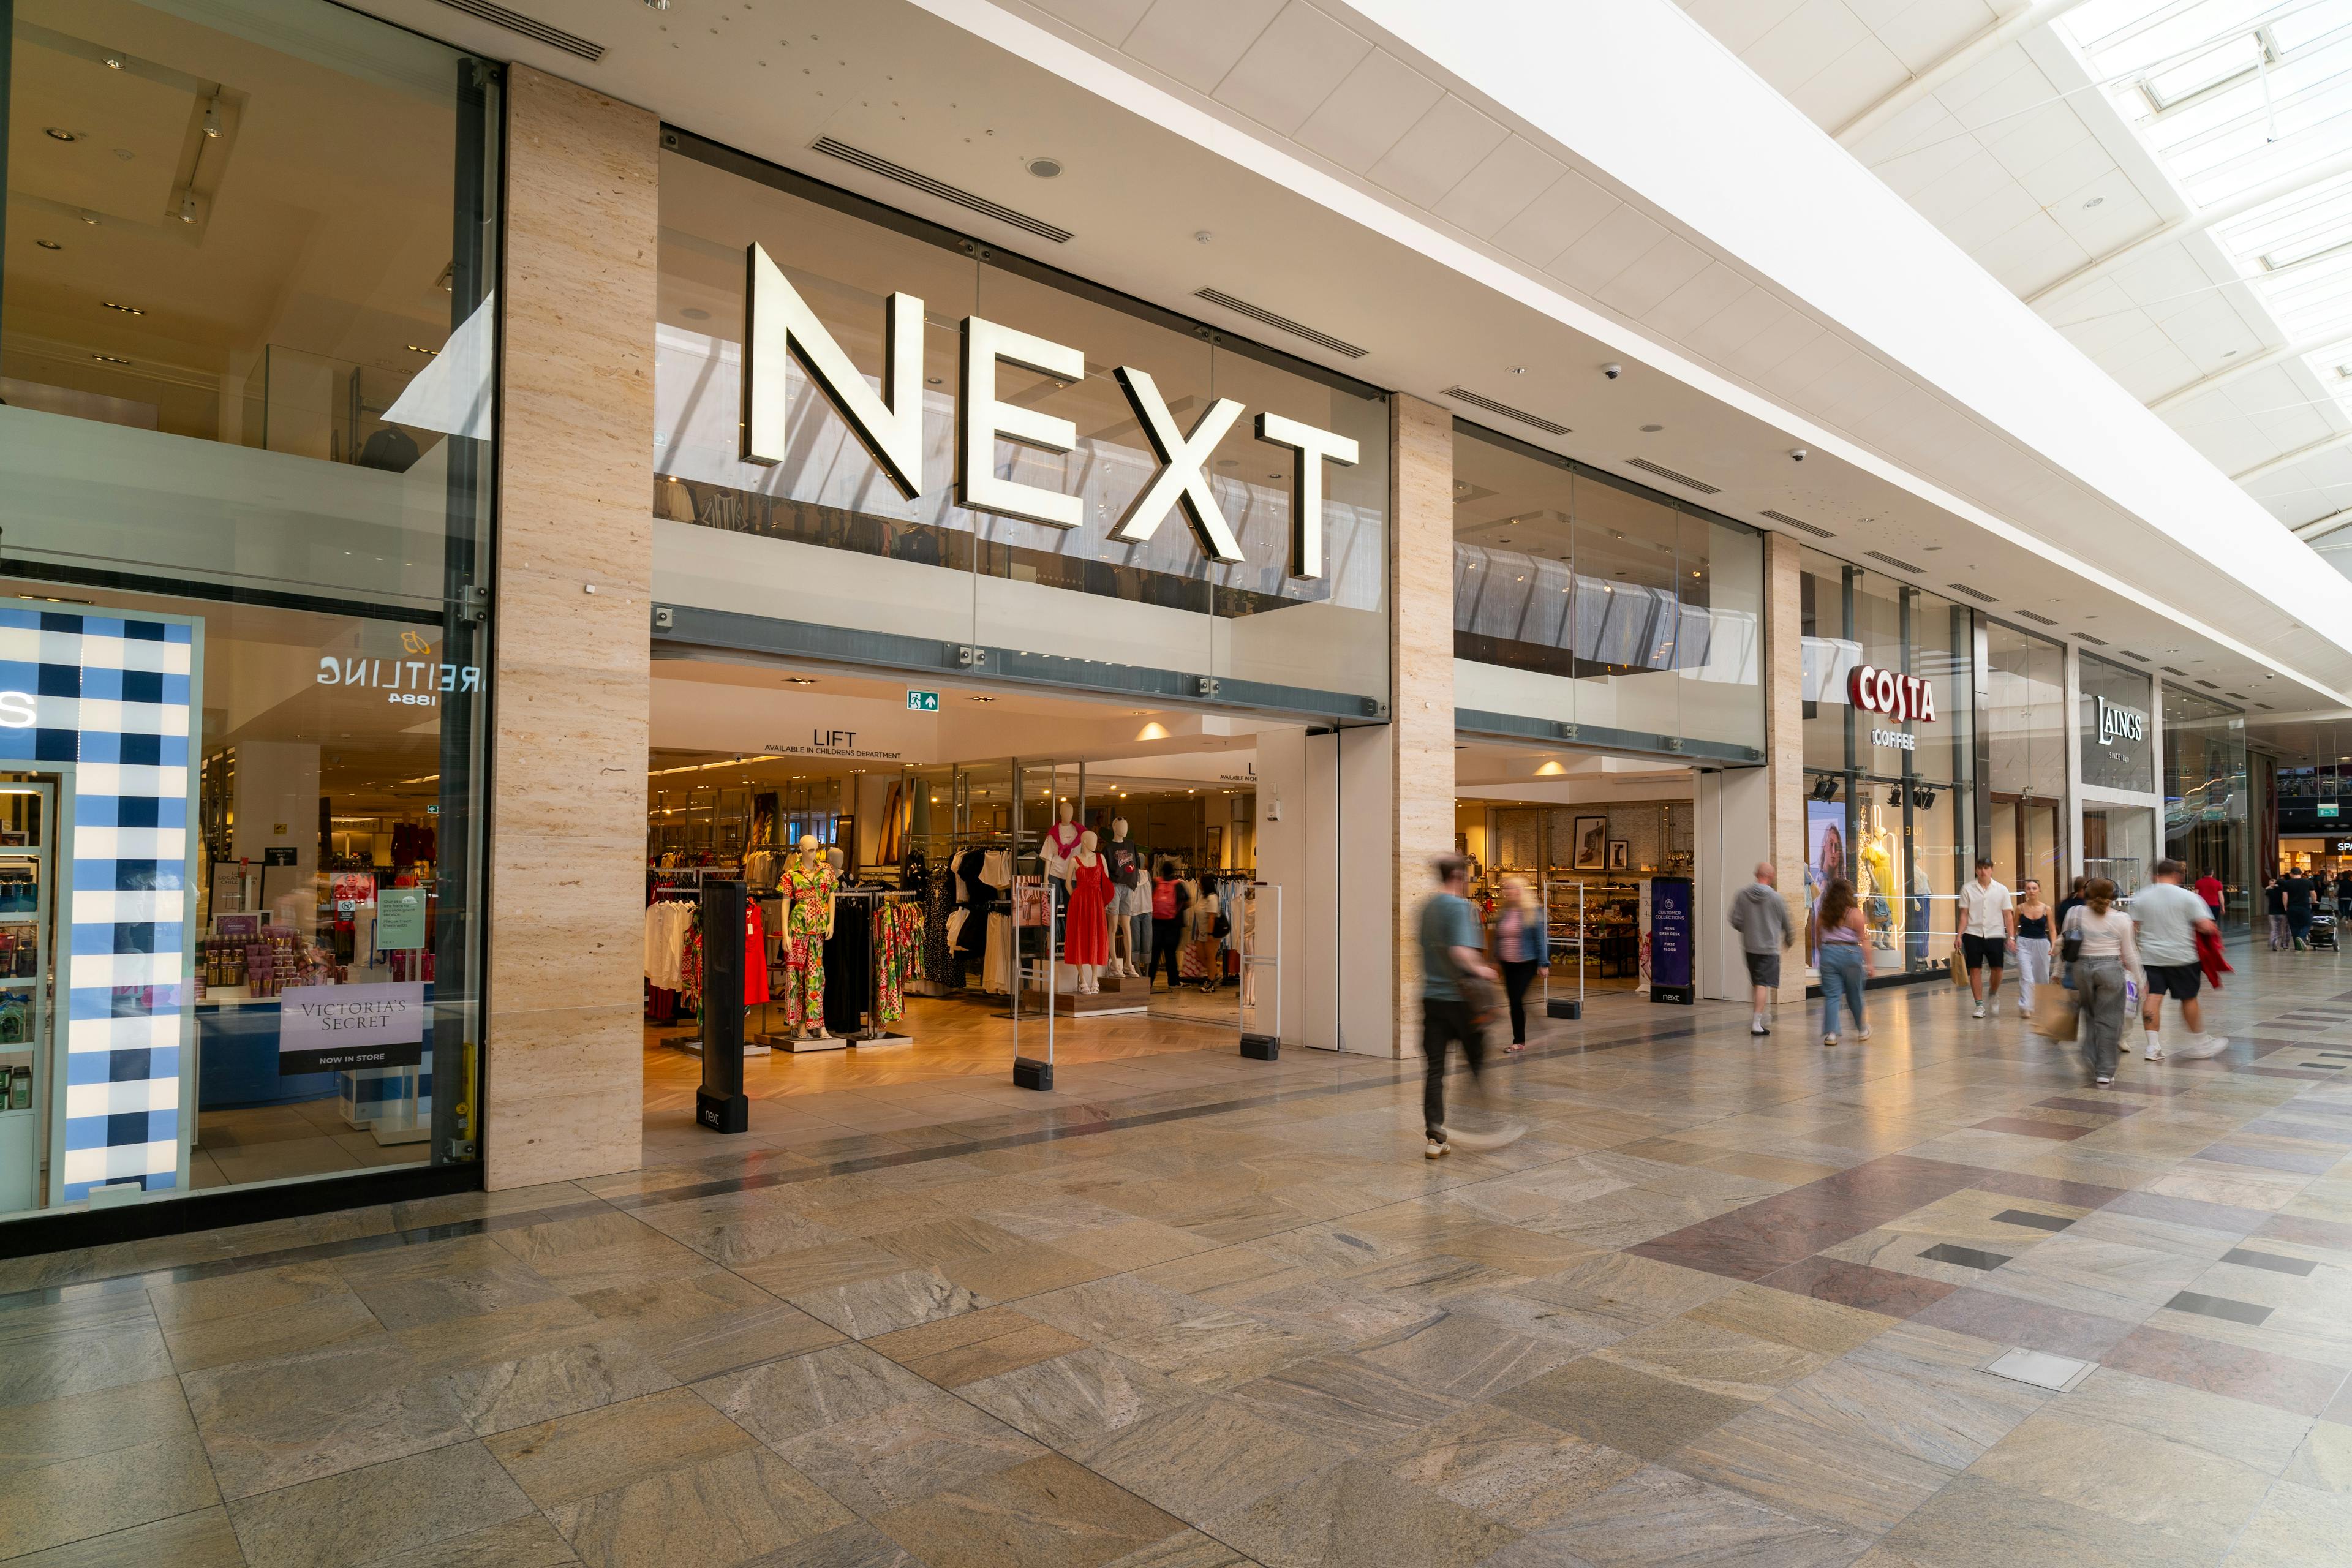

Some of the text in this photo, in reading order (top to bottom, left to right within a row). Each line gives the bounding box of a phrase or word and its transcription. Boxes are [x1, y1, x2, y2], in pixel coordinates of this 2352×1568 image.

[742, 241, 1359, 581] NEXT
[1850, 665, 1936, 723] COSTA
[2097, 695, 2142, 745] LAINGS
[813, 729, 856, 747] LIFT
[1872, 728, 1915, 750] COFFEE
[764, 744, 804, 753] AVAILABLE
[815, 747, 854, 756] CHILDRENS
[856, 750, 901, 759] DEPARTMENT
[2109, 752, 2120, 761] SINCE
[301, 1000, 406, 1016] VICTORIA'S
[322, 1016, 390, 1031] SECRET
[319, 1056, 342, 1065] NOW
[705, 1110, 719, 1125] next
